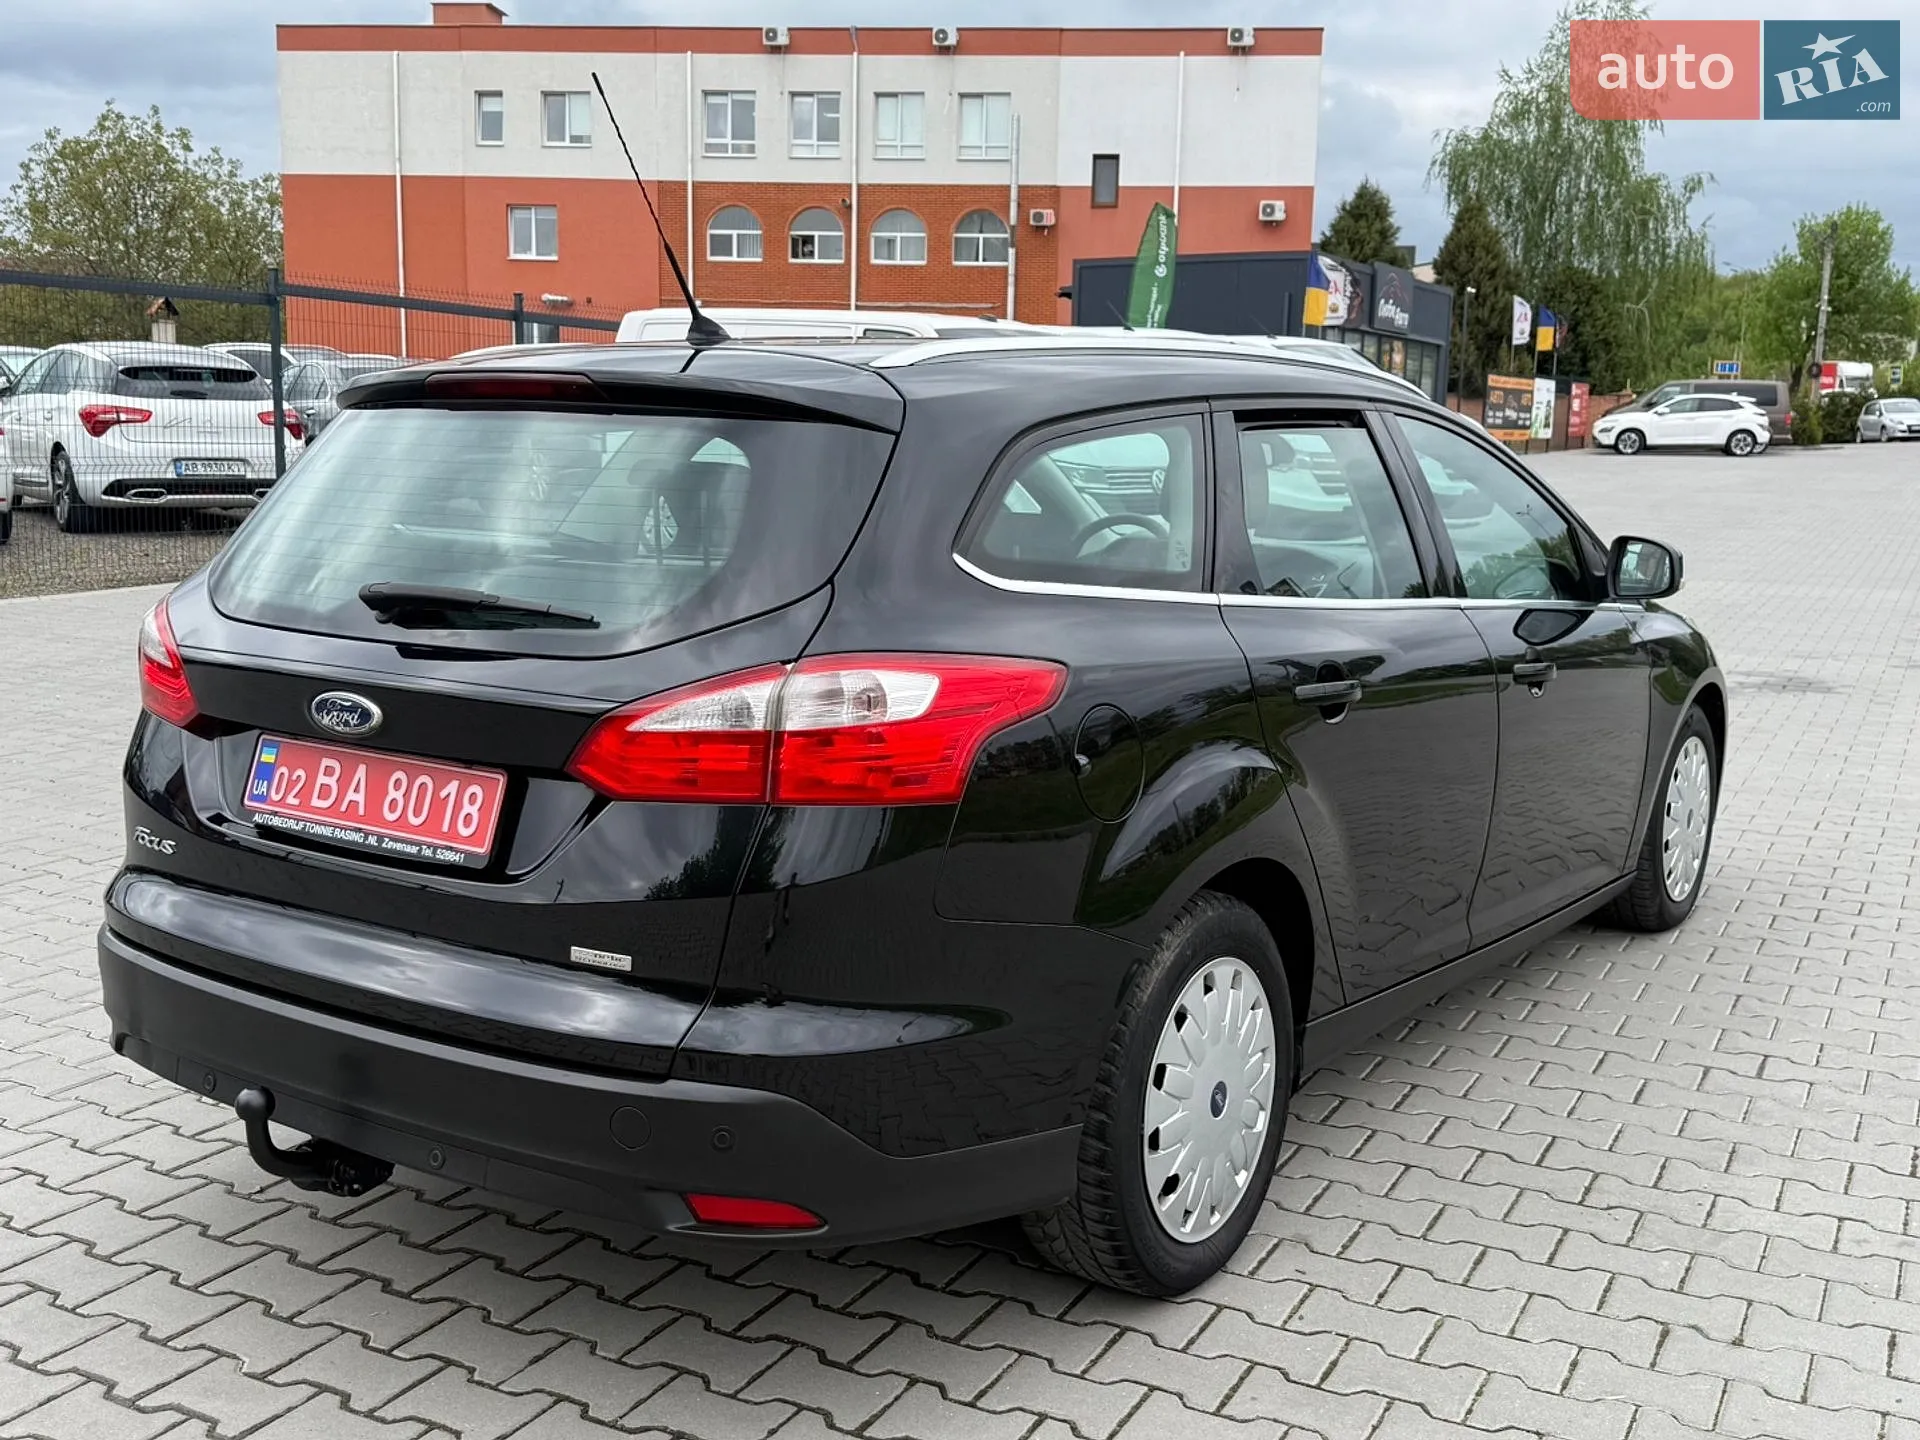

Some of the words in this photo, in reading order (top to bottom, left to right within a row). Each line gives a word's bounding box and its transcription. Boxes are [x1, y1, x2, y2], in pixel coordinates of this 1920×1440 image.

[320, 698, 362, 728] Ford
[253, 778, 268, 796] UA
[270, 765, 308, 806] 02
[310, 757, 369, 817] BA
[382, 770, 485, 838] 8018
